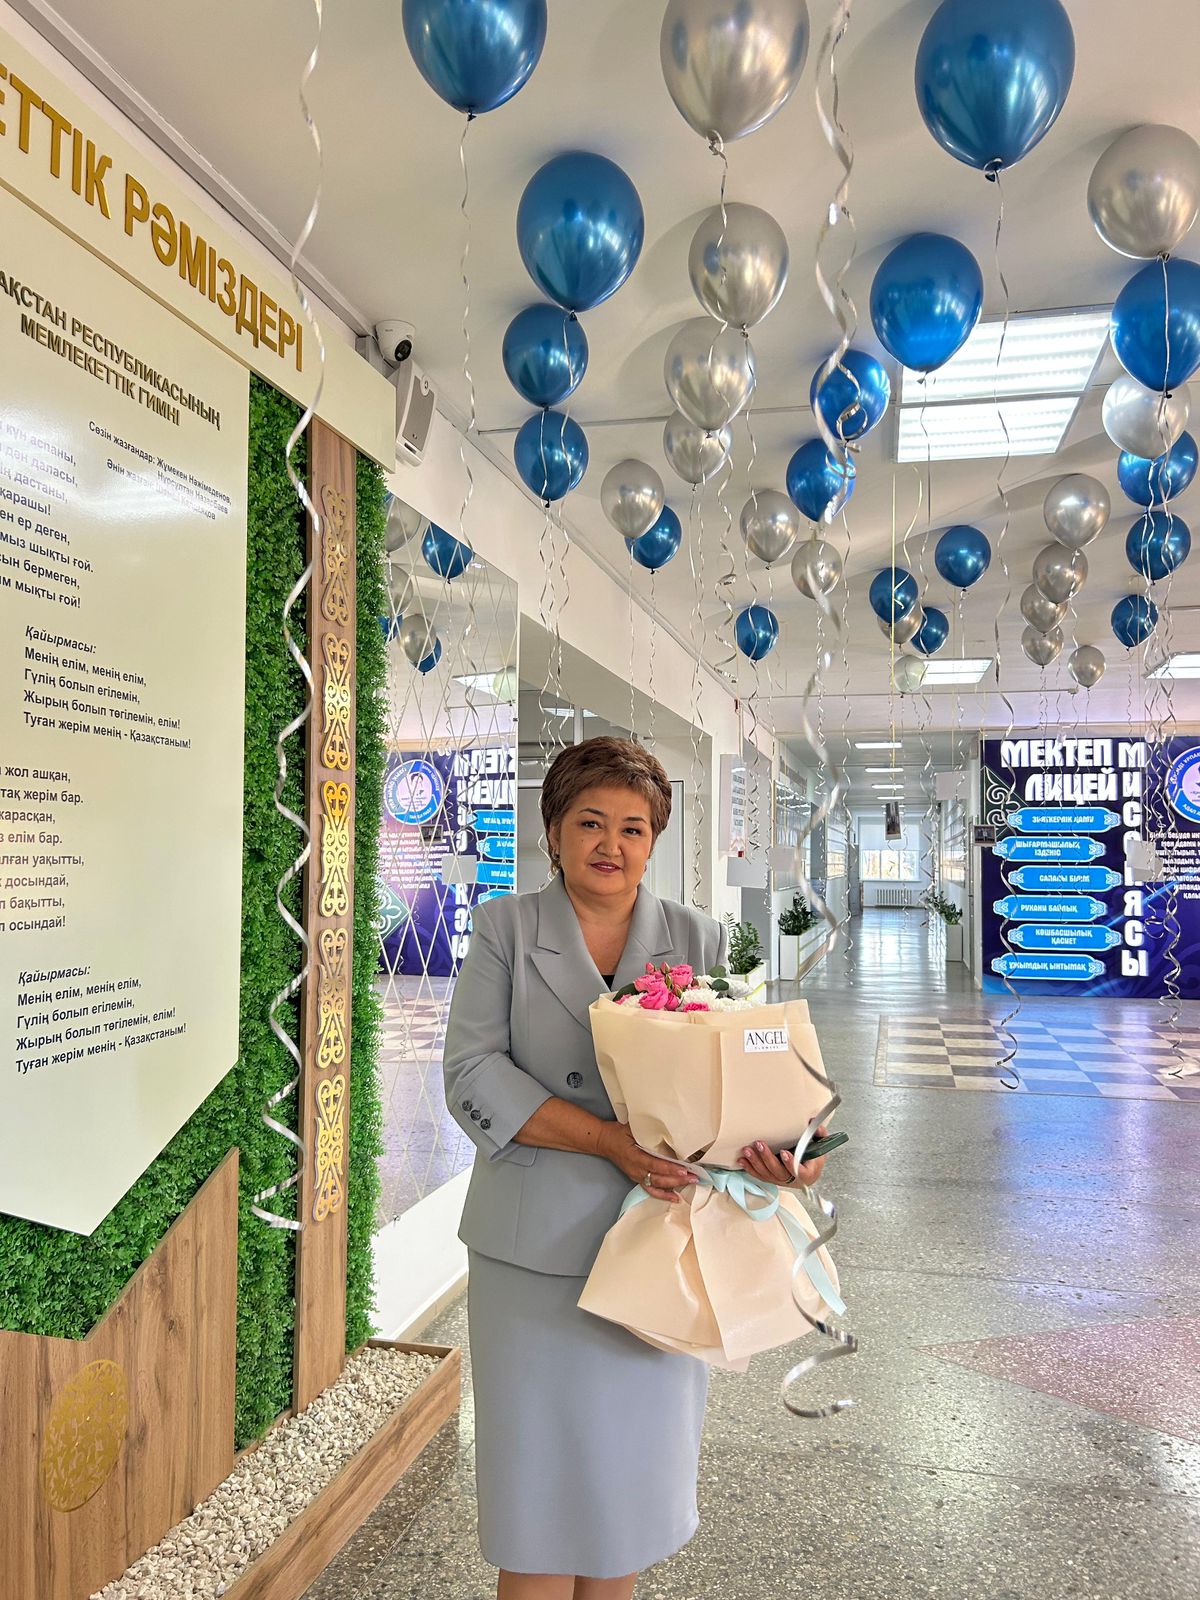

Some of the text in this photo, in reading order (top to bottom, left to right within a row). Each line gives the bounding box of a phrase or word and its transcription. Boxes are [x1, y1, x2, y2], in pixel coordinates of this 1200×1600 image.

[0, 62, 302, 372] ТТІК РӘМІЗДЕРІ
[21, 313, 180, 426] МЕМЛЕКЕТТІК ГИМНІ
[71, 317, 221, 431] РЕСПУБЛИКАСЫНЫҢ
[30, 435, 76, 467] аспаны,
[88, 420, 112, 441] Сөзін
[113, 436, 156, 464] жазғандар:
[31, 458, 78, 488] даласы,
[107, 458, 125, 475] Әнін
[14, 472, 68, 504] дастаны,
[17, 516, 32, 531] ер
[35, 523, 70, 546] деген,
[29, 541, 70, 564] шықты
[73, 558, 94, 573] ғой.
[23, 559, 80, 590] бермеген,
[15, 580, 56, 601] мықты
[59, 593, 81, 609] ғой!
[25, 625, 97, 654] Қайырмасы:
[25, 647, 147, 687] Менің елім, менің елім,
[25, 668, 141, 705] Гүлің болып егілемін,
[24, 690, 181, 730] Жырың болып төгілемін, елім!
[23, 711, 56, 728] Туған
[58, 719, 90, 734] жерім
[93, 726, 122, 740] менің
[130, 729, 191, 749] Қазақстаным!
[1001, 738, 1113, 768] МЕКТЕП
[5, 766, 29, 777] жол
[32, 768, 71, 784] ашқан,
[1024, 767, 1118, 805] ЛИЦЕЙ
[0, 788, 84, 805] тақ жерім бар.
[8, 831, 35, 843] елім
[39, 832, 63, 846] бар.
[32, 855, 85, 868] уақытты,
[5, 873, 69, 889] досындай,
[10, 896, 65, 910] бақытты,
[9, 915, 66, 931] осындай!
[18, 965, 91, 986] Қайырмасы:
[17, 977, 142, 1007] Менің елім, менің елім,
[17, 997, 135, 1030] Гүлің болып егілемін,
[16, 1007, 176, 1051] Жырың болып төгілемін, елім!
[746, 1031, 787, 1046] ANGEL
[16, 1056, 49, 1075] Туған
[51, 1048, 84, 1065] жерім
[87, 1040, 116, 1056] менің
[124, 1023, 186, 1048] Қазақстаным!
